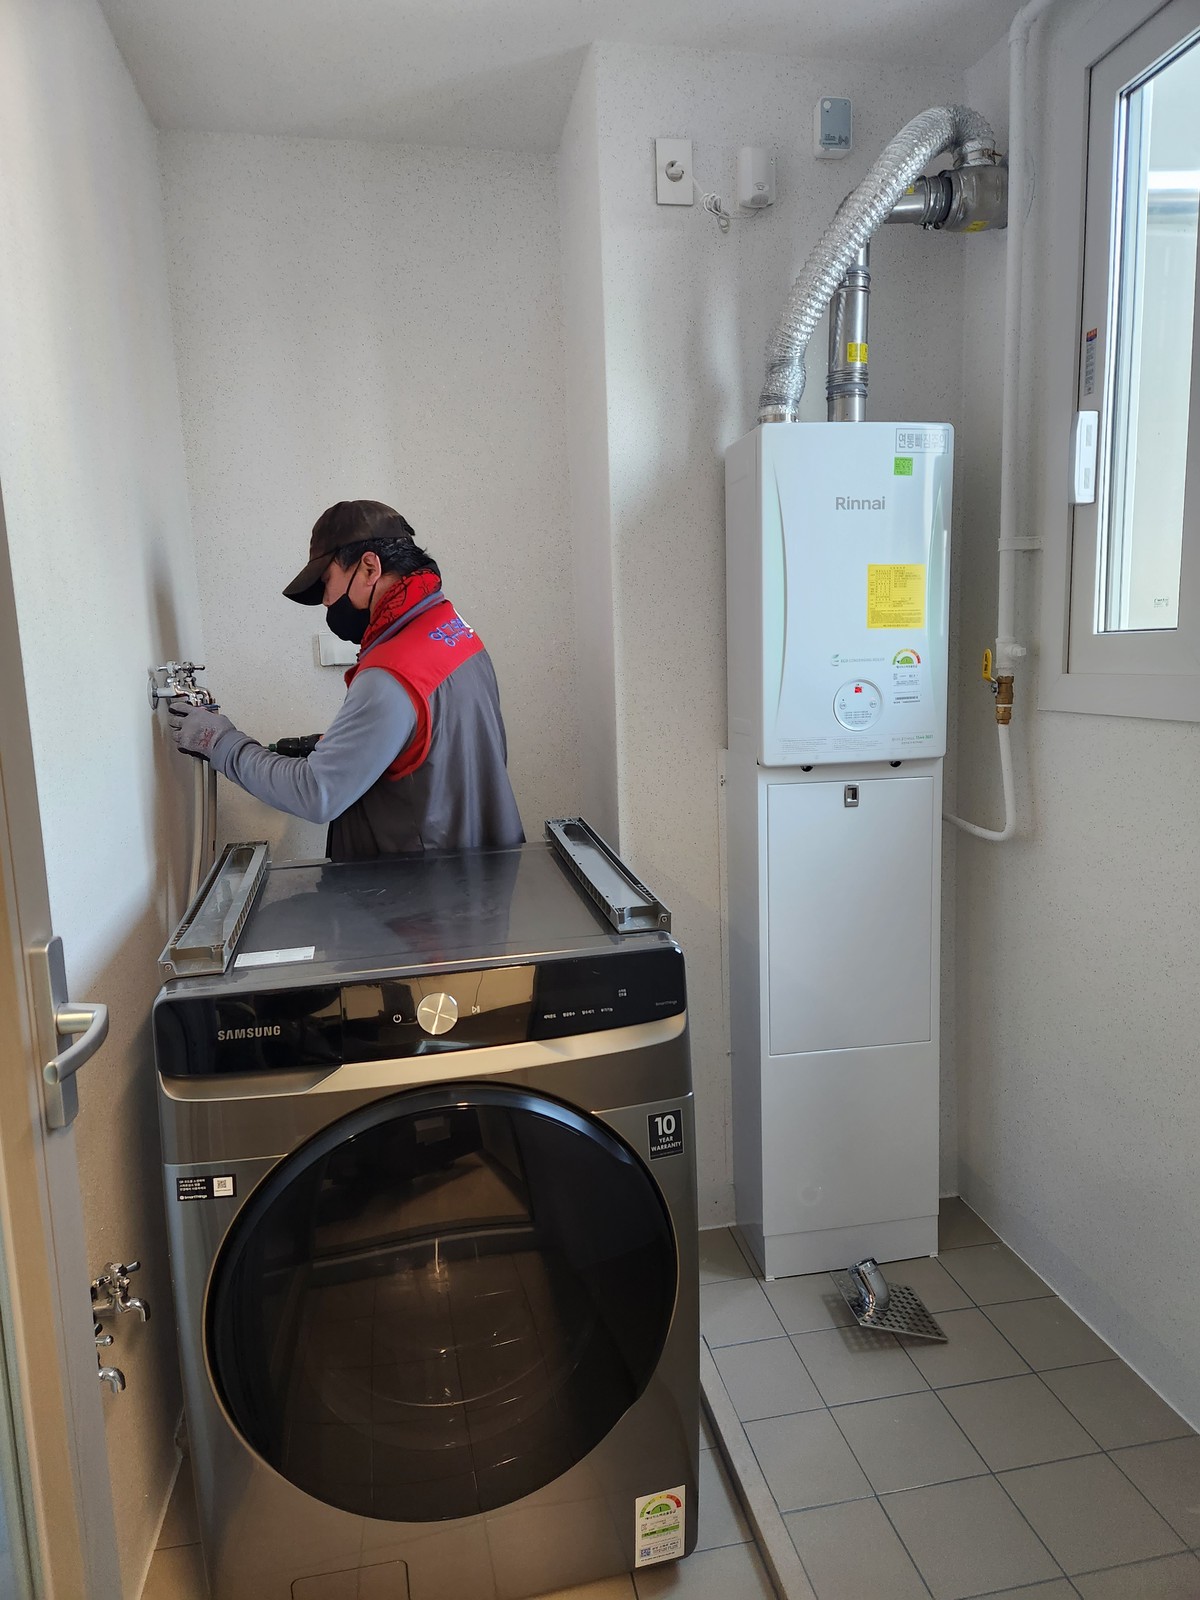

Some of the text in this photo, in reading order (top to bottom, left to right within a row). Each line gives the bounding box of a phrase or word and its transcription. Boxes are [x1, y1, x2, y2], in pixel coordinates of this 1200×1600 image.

[835, 496, 886, 510] Rinnai
[217, 1025, 281, 1041] SAMSUNG
[654, 1114, 676, 1136] 10
[651, 1141, 681, 1151] WARRANTY
